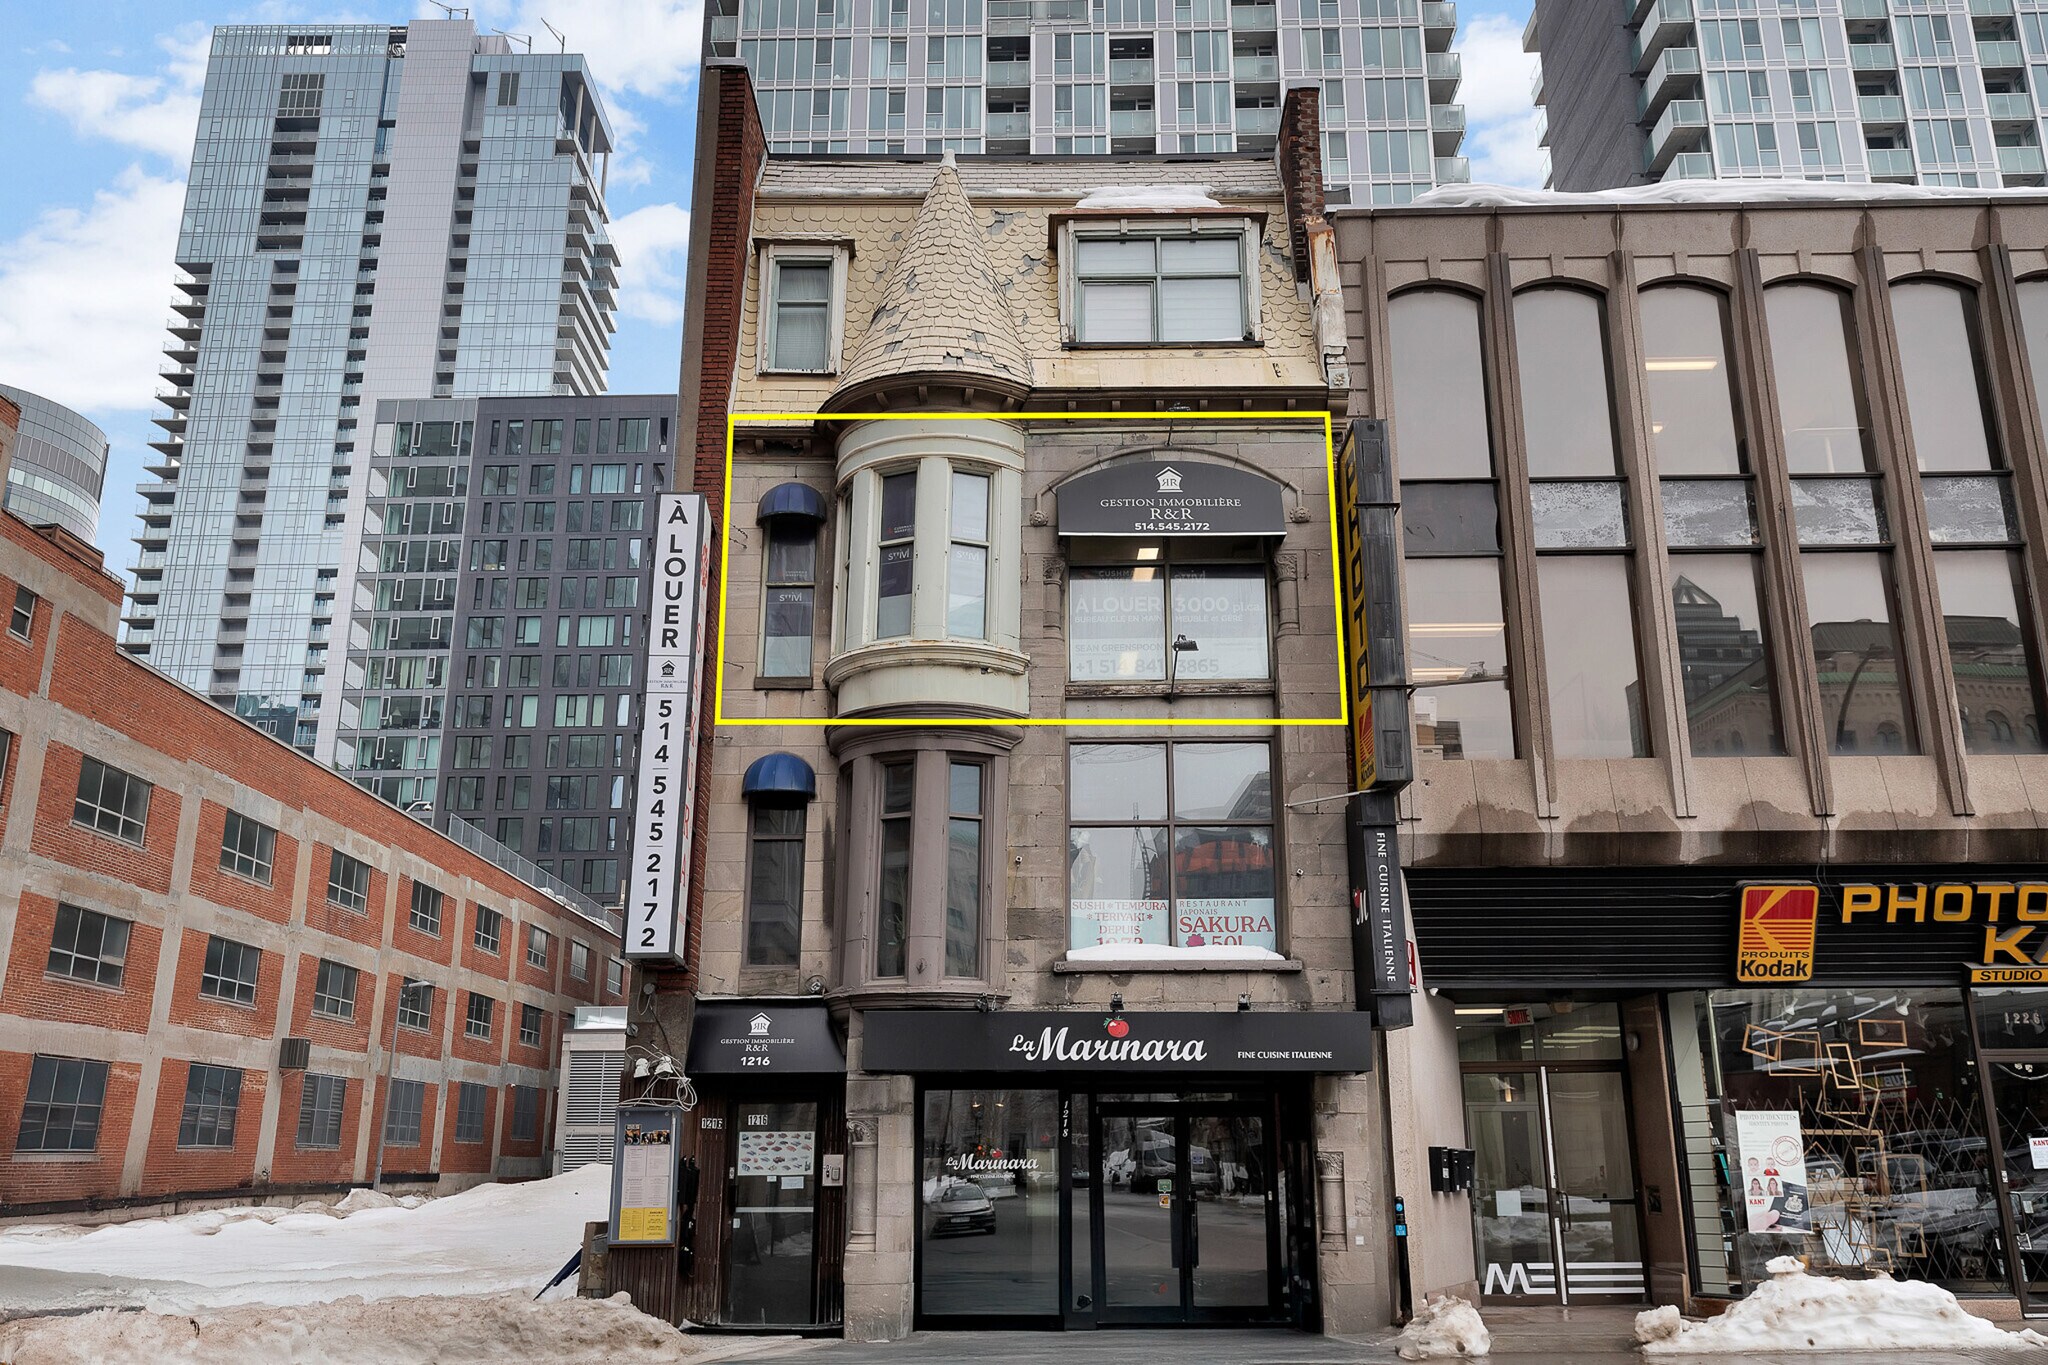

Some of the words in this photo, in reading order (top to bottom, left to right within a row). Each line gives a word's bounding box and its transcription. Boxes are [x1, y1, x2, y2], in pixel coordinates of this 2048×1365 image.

[1100, 499, 1155, 507] GESTION
[1159, 497, 1241, 507] IMMOBILIÈRE
[667, 500, 688, 524] À
[1150, 508, 1194, 520] R&R
[1135, 523, 1210, 531] 514.545.2172
[661, 534, 687, 648] LOUER
[1093, 596, 1162, 612] LOUER
[1175, 596, 1229, 613] 3000
[1075, 644, 1099, 652] SEAN
[1101, 643, 1163, 652] GREENSPOON
[1076, 659, 1093, 674] +1
[1135, 658, 1164, 673] 841
[1177, 659, 1219, 673] 3865
[1377, 832, 1387, 858] FINE
[1378, 865, 1391, 913] CUISINE
[1072, 901, 1105, 910] SUSHI
[1115, 901, 1167, 910] TEMPURA
[1842, 885, 2048, 923] PHOTO
[1095, 913, 1145, 921] TERIYAKI
[1180, 908, 1218, 916] JAPONAIS
[1099, 925, 1140, 934] DEPUIS
[1180, 916, 1273, 933] SAKURA
[1382, 920, 1397, 982] ITALIENNE
[1983, 926, 2048, 964] K
[1740, 960, 1808, 977] Kodak
[1980, 971, 2043, 981] STUDIO
[2004, 1012, 2041, 1024] 1226
[745, 1044, 768, 1052] R&R
[1009, 1034, 1035, 1052] La
[1025, 1026, 1208, 1061] Marinara
[740, 1056, 770, 1066] 1216
[1237, 1051, 1256, 1059] FINE
[1257, 1051, 1290, 1059] CUISINE
[1291, 1051, 1333, 1059] ITALIENNE
[747, 1114, 769, 1126] 1216
[946, 1156, 958, 1166] La
[953, 1153, 1039, 1170] Marinara
